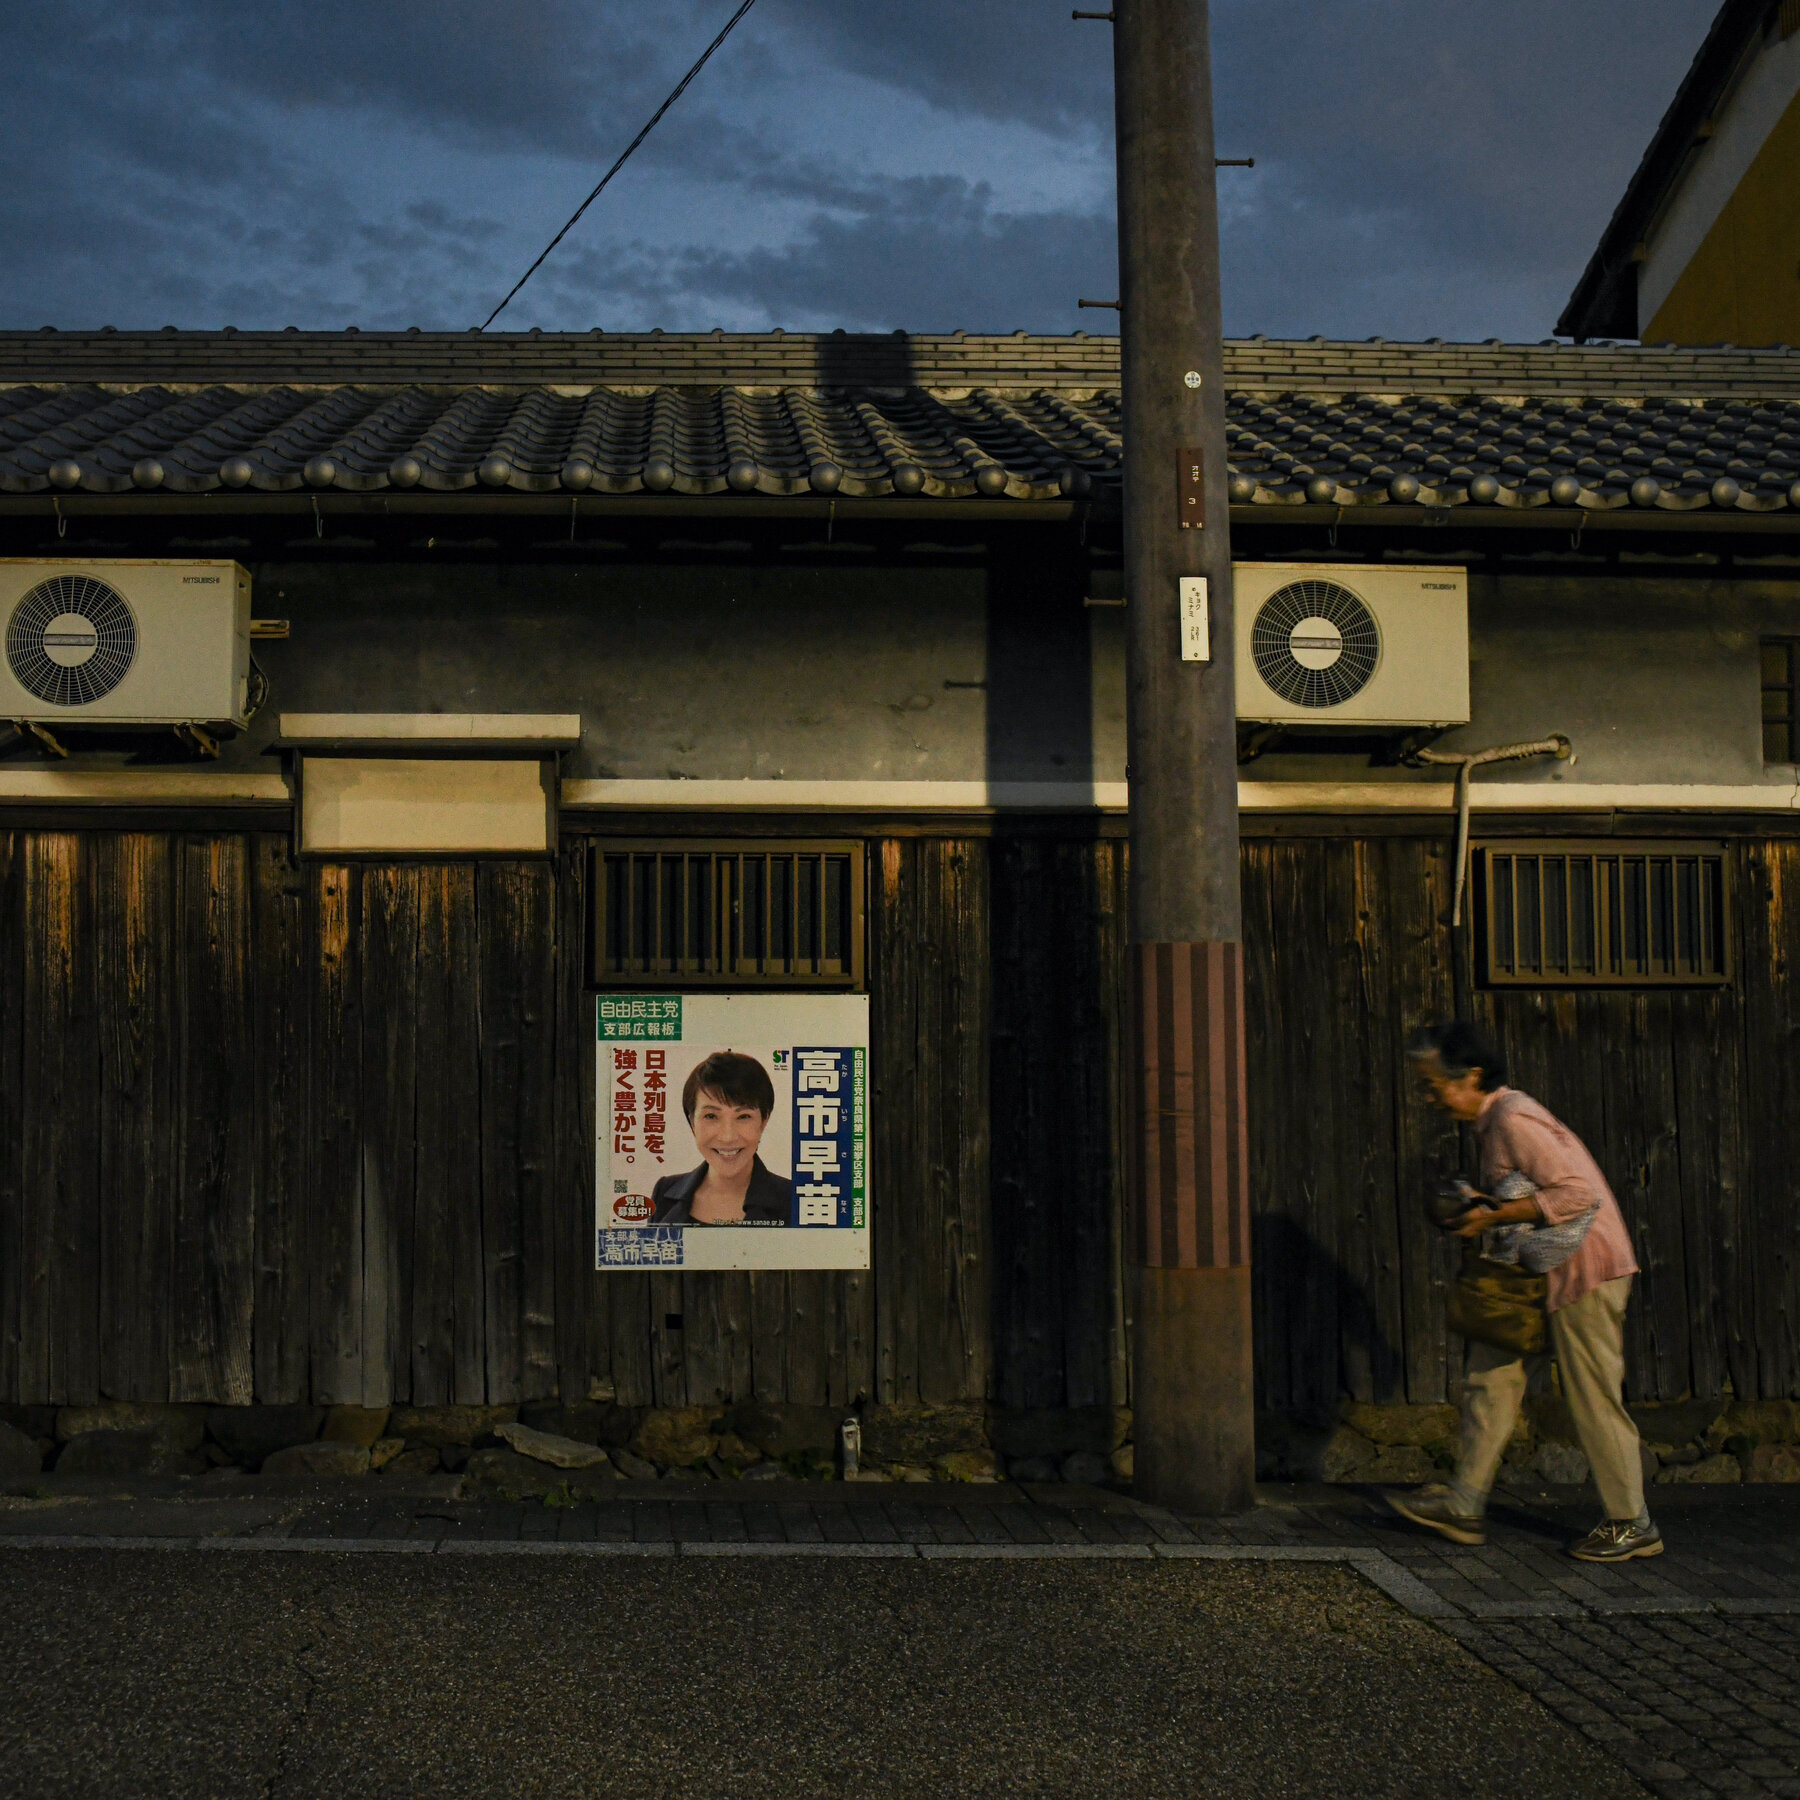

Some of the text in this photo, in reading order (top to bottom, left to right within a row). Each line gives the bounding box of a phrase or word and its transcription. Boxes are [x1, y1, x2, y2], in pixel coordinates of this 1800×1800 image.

[601, 1001, 679, 1018] 自由民主党
[604, 1022, 675, 1036] 支部広報板
[614, 1049, 637, 1163] 強く豊かに。
[643, 1050, 667, 1163] 日本列島を、
[796, 1050, 841, 1225] 高市早苗
[605, 1242, 678, 1262] 高市早苗
